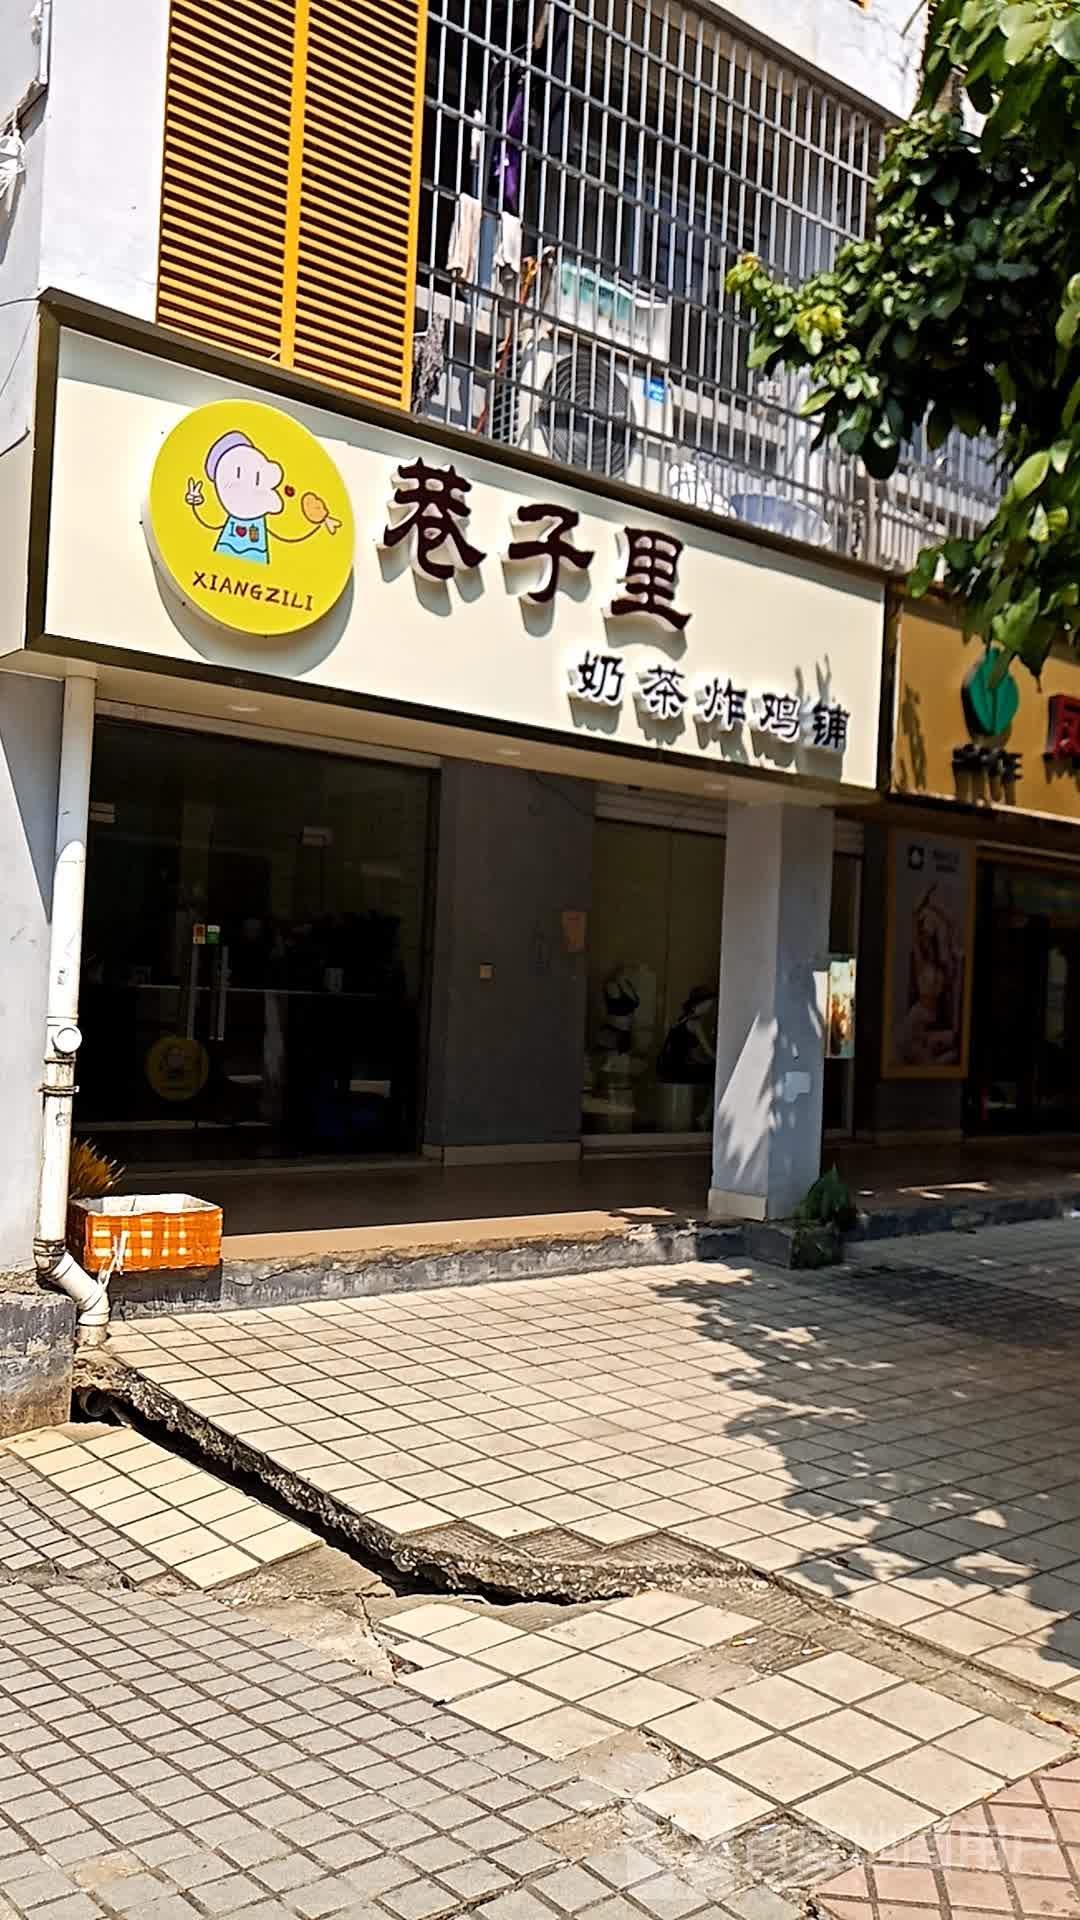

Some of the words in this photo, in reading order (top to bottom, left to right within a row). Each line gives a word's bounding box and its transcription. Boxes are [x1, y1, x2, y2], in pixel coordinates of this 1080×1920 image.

[192, 570, 313, 611] XIANGZILI
[384, 457, 692, 630] 巷子里
[578, 650, 850, 749] 奶茶炸鸡铺
